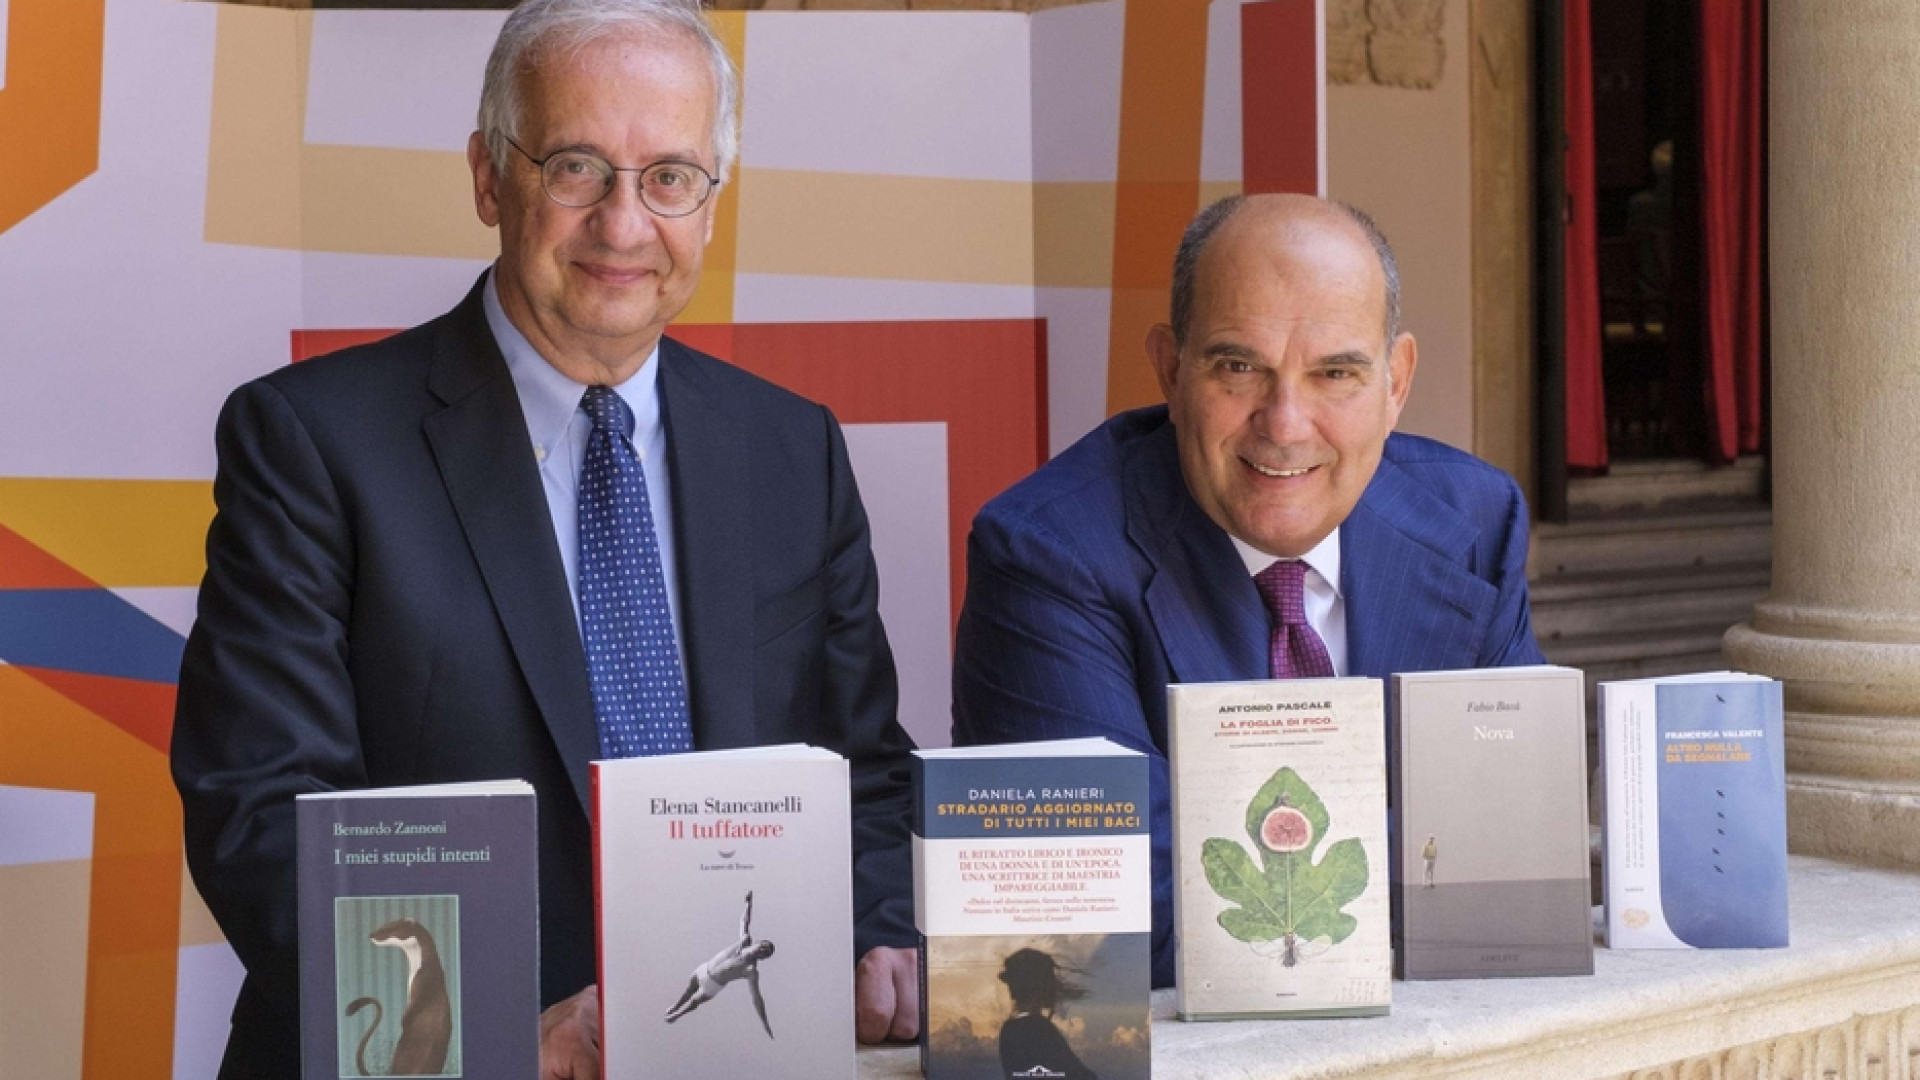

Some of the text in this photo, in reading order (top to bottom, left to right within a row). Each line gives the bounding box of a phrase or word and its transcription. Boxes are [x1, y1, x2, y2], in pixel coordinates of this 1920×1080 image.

[1218, 701, 1332, 714] ANTONIO PASCALE
[1467, 700, 1495, 713] Fabio
[1221, 716, 1331, 729] LA FOGLIA DI FICO
[1473, 725, 1514, 741] Nova
[1664, 729, 1764, 740] FRANCESCA VALENTE
[1665, 741, 1742, 752] ALTRO NULLA
[1665, 752, 1752, 763] DA SEGNALARE
[968, 787, 1105, 800] DANIELA RANIERI
[649, 795, 803, 816] Elena Stancanelli
[936, 802, 1136, 815] STRADARIO AGGIORNATO
[333, 820, 447, 836] Bernardo Zannoni
[983, 815, 1141, 829] DI TUTTI I MIEI BACI
[669, 818, 785, 840] Il tuffatore
[334, 845, 491, 867] I miei stupidi intenti
[959, 850, 969, 860] IL
[971, 849, 1027, 860] RITRATTO
[1027, 849, 1066, 859] LIRICO
[1076, 847, 1124, 858] IRONICO
[959, 861, 971, 871] DI
[974, 861, 998, 871] UNA
[999, 860, 1041, 870] DONNA
[1052, 860, 1064, 869] DI
[961, 869, 1121, 882] UNA SCRITTRICE DI MAESTRIA
